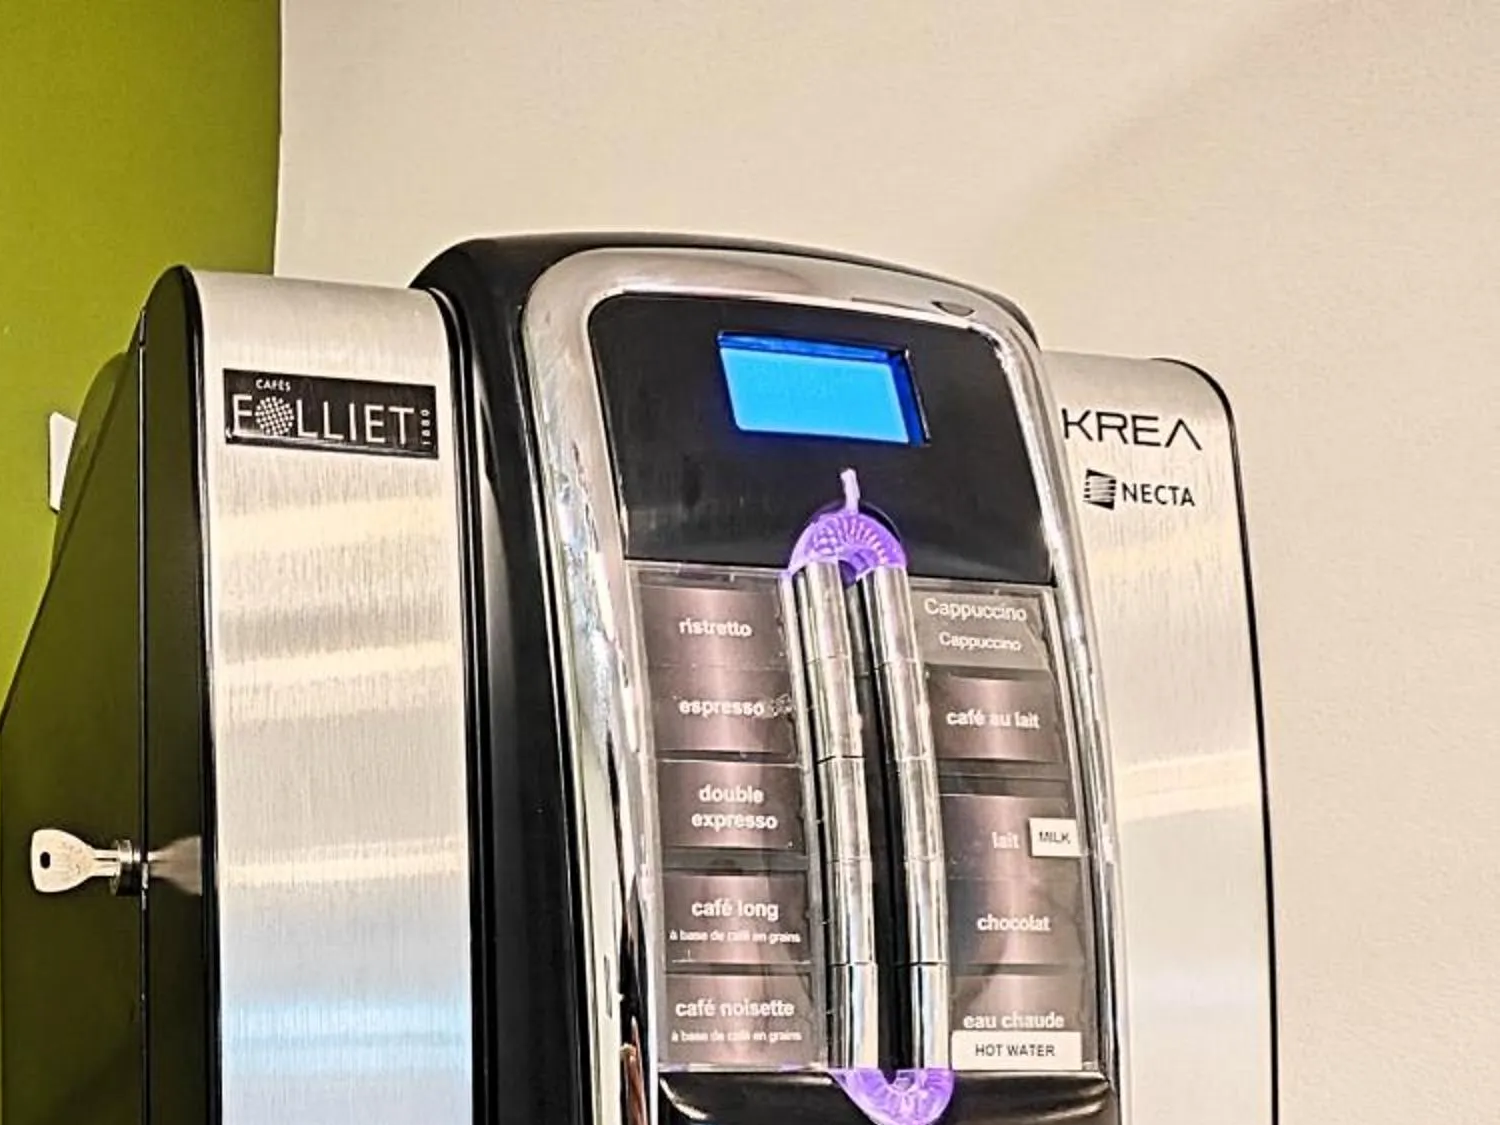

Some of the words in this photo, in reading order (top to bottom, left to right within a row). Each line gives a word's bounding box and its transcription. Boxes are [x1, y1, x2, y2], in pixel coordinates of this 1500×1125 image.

[1122, 482, 1196, 507] NECTA
[924, 597, 1028, 624] Cappuccino
[678, 618, 753, 638] ristretto
[939, 632, 1022, 653] Cappuccino
[678, 700, 765, 717] espresso
[946, 708, 984, 728] café
[989, 713, 1011, 728] au
[1015, 711, 1041, 730] lait
[699, 784, 764, 804] double
[691, 812, 778, 832] expresso
[992, 830, 1020, 850] lait
[1038, 831, 1072, 845] MILK
[691, 898, 733, 918] café
[738, 899, 780, 922] long
[977, 913, 1052, 933] chocolat
[675, 997, 716, 1018] café
[720, 997, 796, 1018] noisette
[963, 1014, 996, 1030] eau
[1001, 1012, 1065, 1030] chaude
[975, 1043, 1004, 1058] HOT
[1008, 1043, 1055, 1058] WATER
